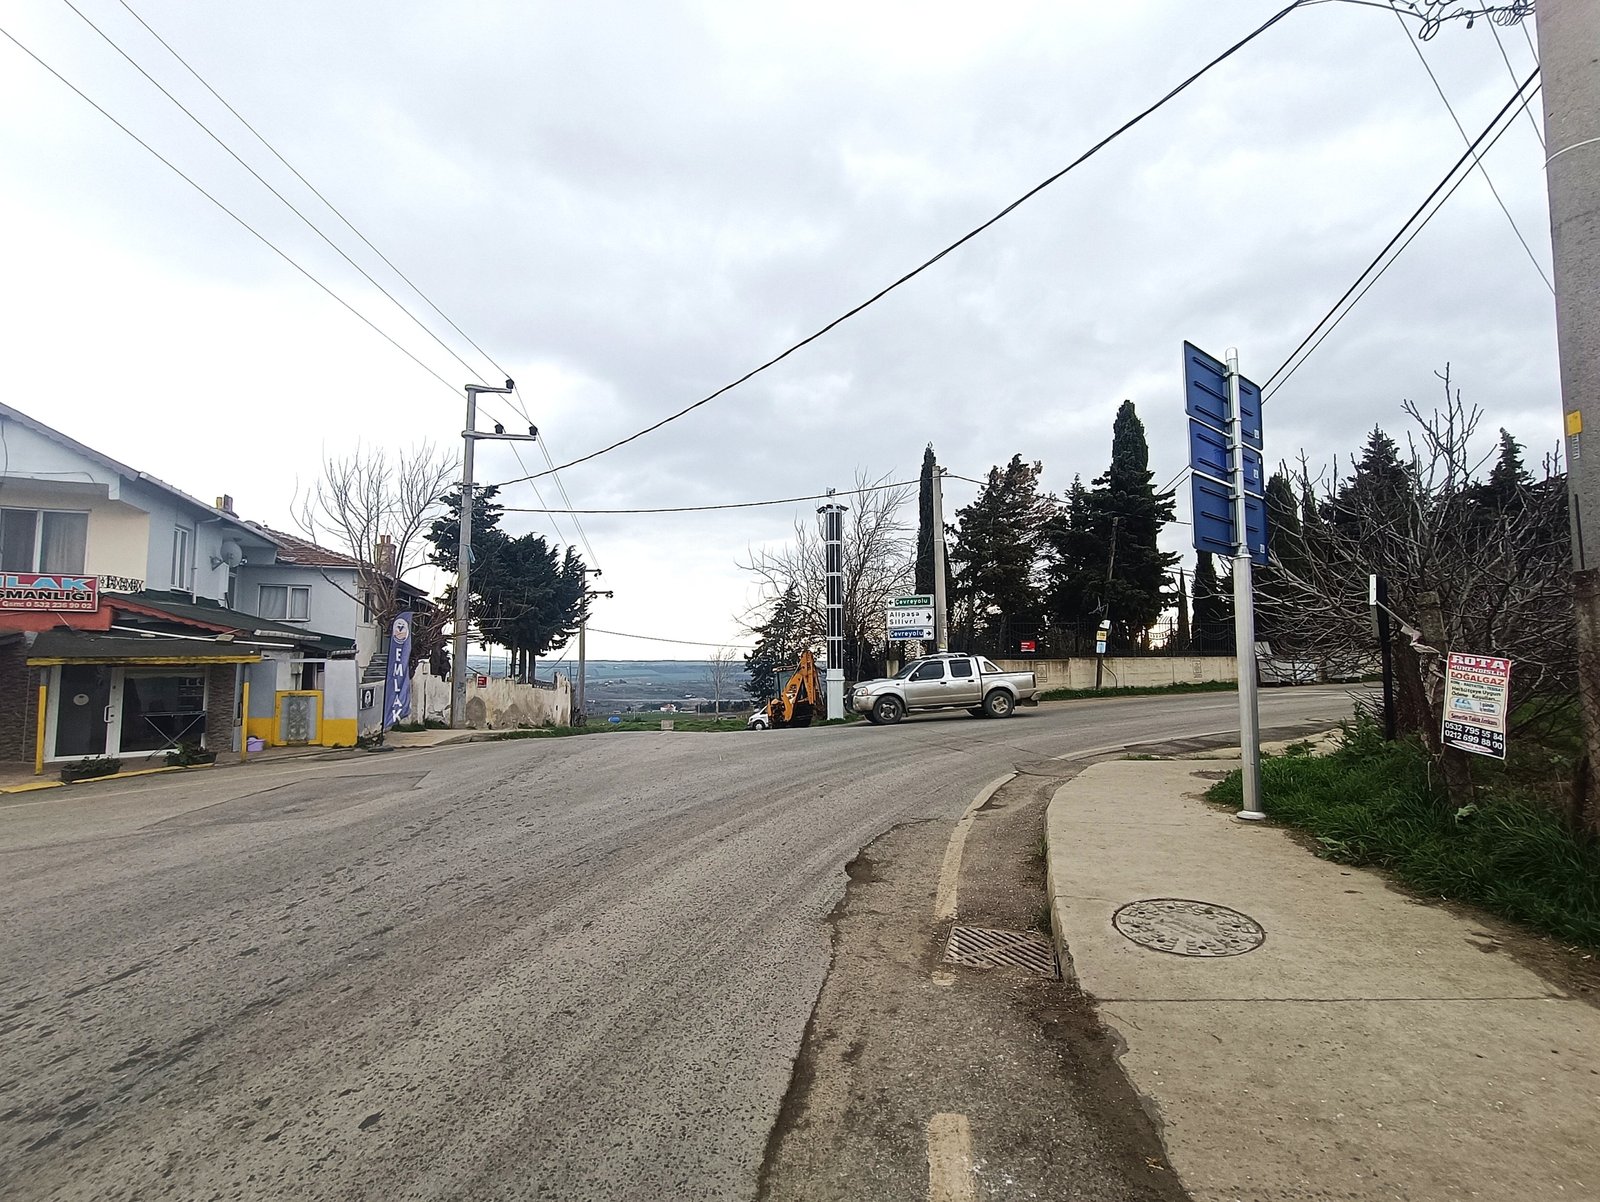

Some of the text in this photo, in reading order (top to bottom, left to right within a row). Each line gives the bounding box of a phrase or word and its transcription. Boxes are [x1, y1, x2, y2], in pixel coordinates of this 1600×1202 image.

[1451, 655, 1505, 669] ROTA
[392, 648, 404, 722] EMLAK
[1451, 671, 1504, 685] DOĞALGAZ
[1444, 730, 1462, 739] 0212
[1462, 734, 1479, 743] 699
[1481, 738, 1491, 747] 88
[1492, 741, 1503, 749] 00
[1445, 722, 1503, 741] 0532 795 55 84
